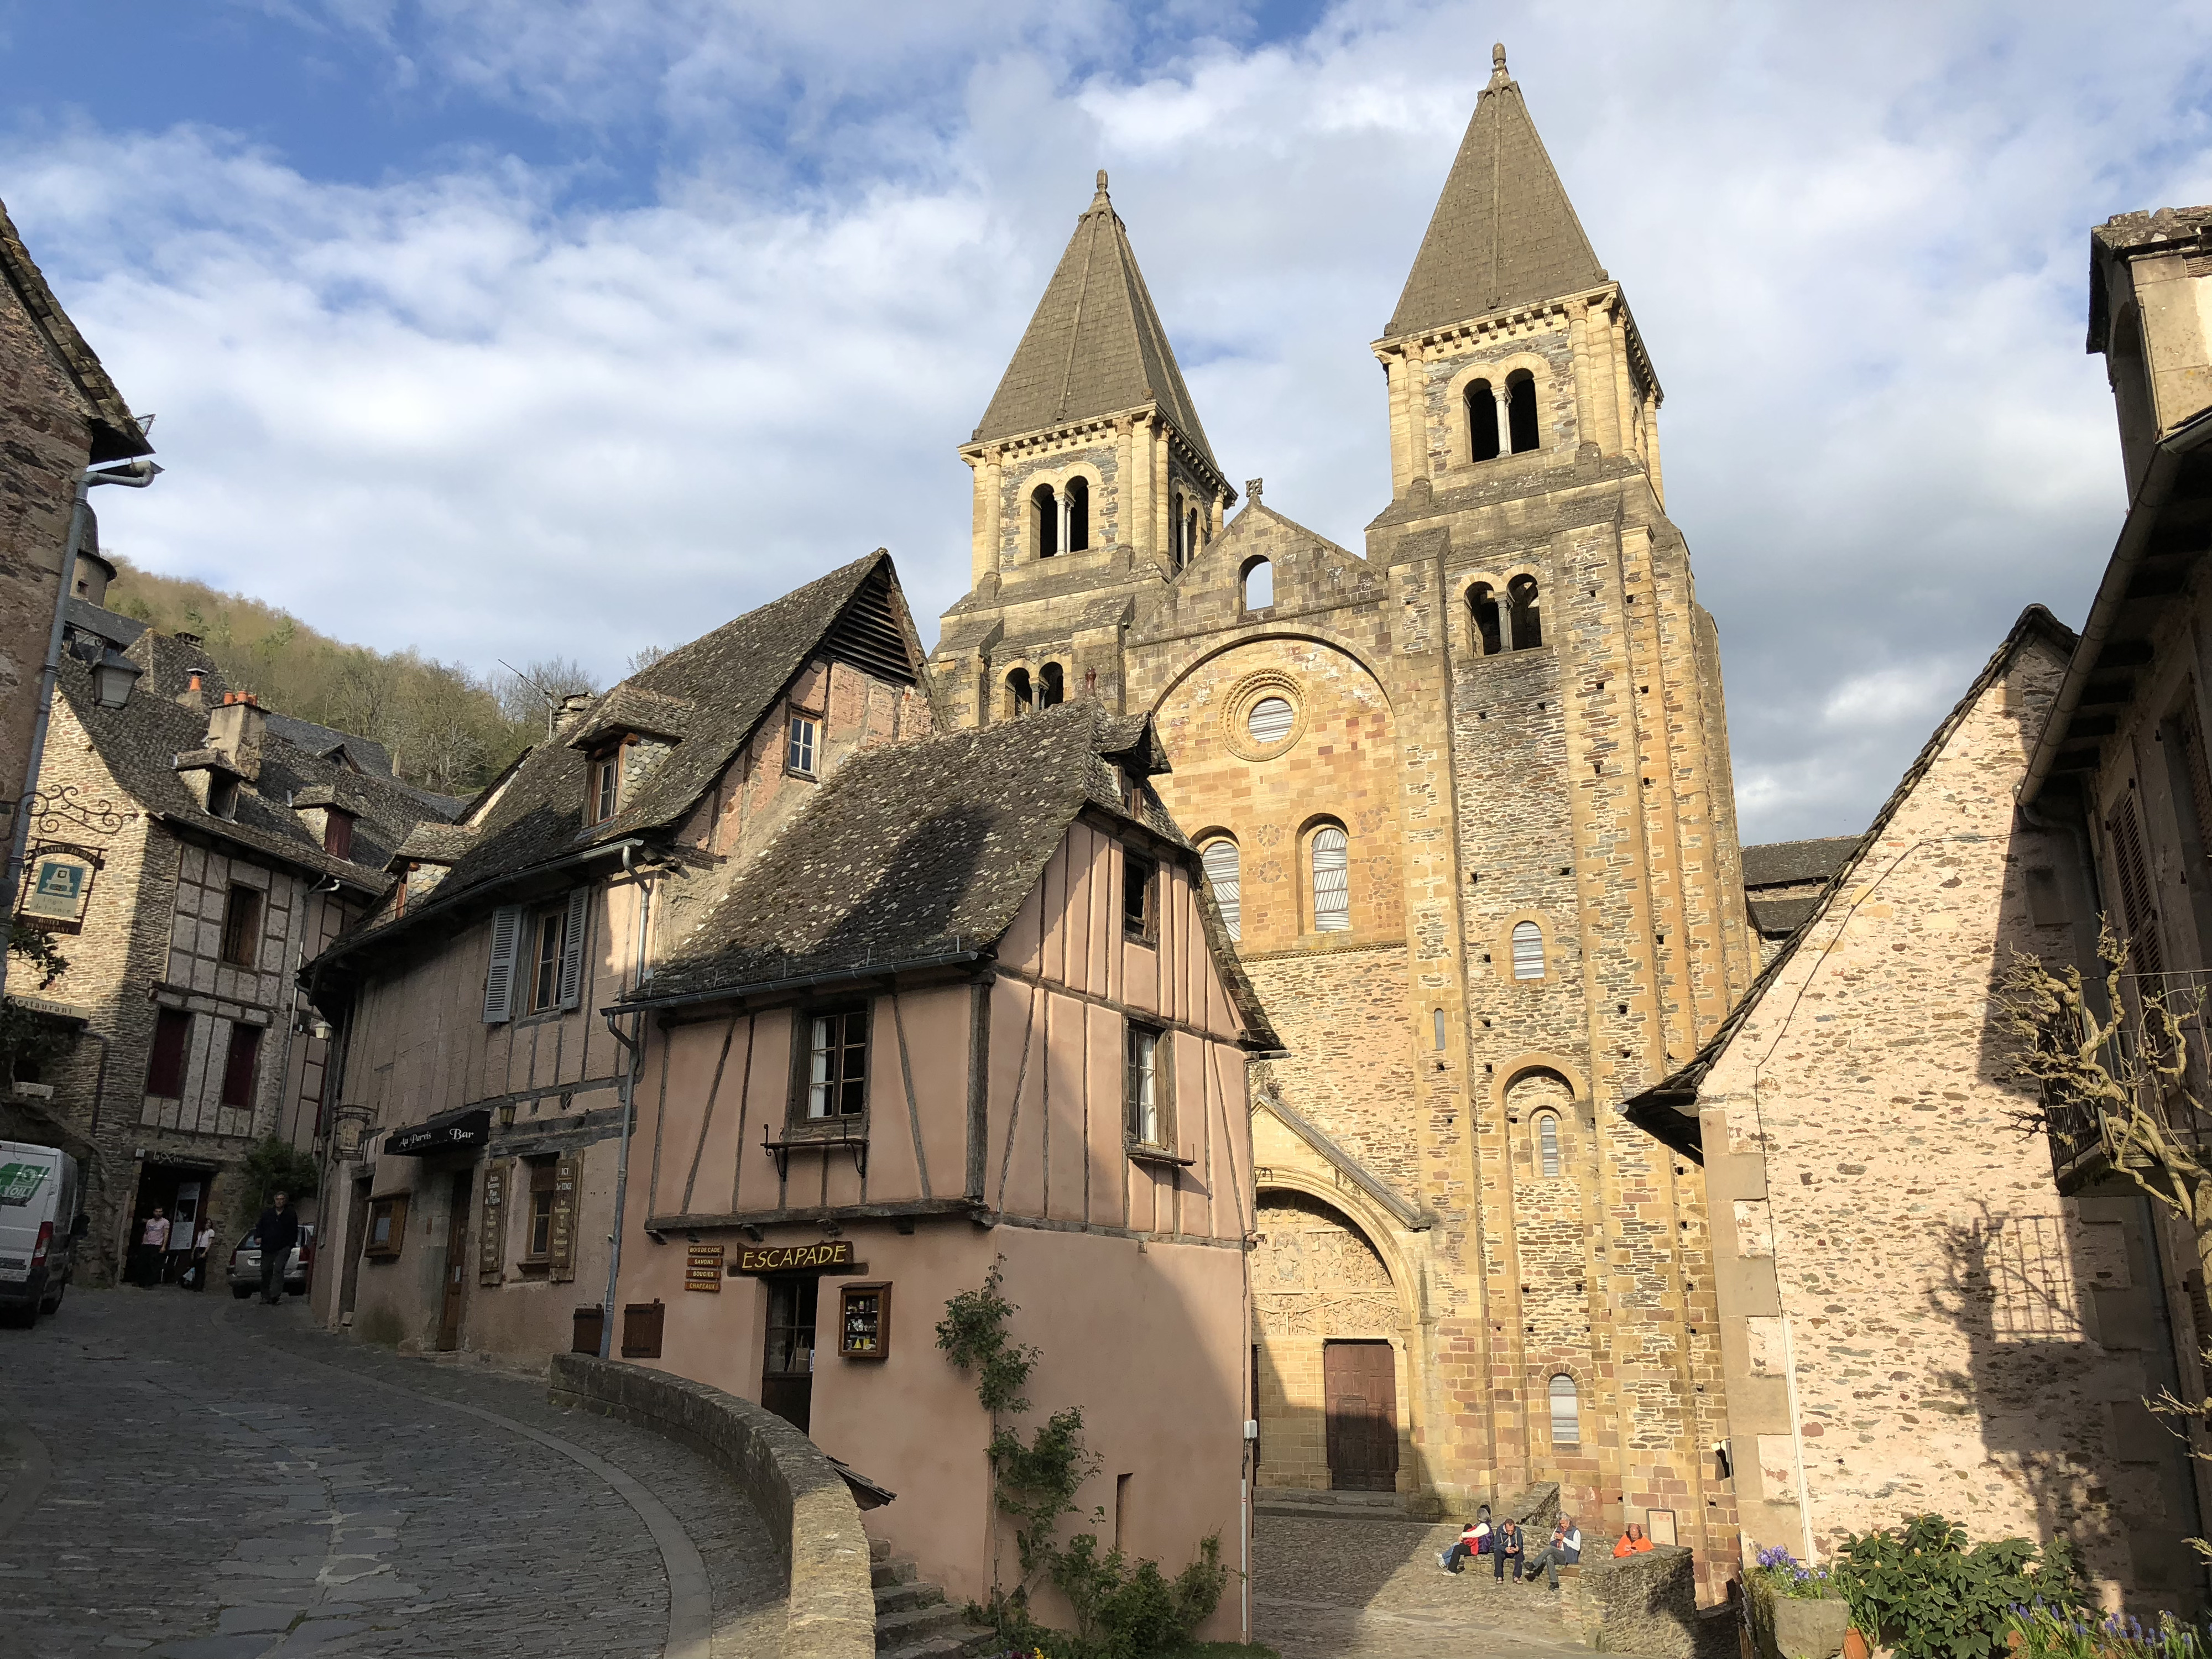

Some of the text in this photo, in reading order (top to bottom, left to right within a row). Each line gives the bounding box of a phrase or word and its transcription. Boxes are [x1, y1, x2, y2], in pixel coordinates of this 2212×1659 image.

[43, 896, 63, 905] Logis
[9, 995, 72, 1014] Restaurant
[399, 1128, 474, 1147] Au Parvis Bar
[742, 1245, 847, 1269] ESCAPADE
